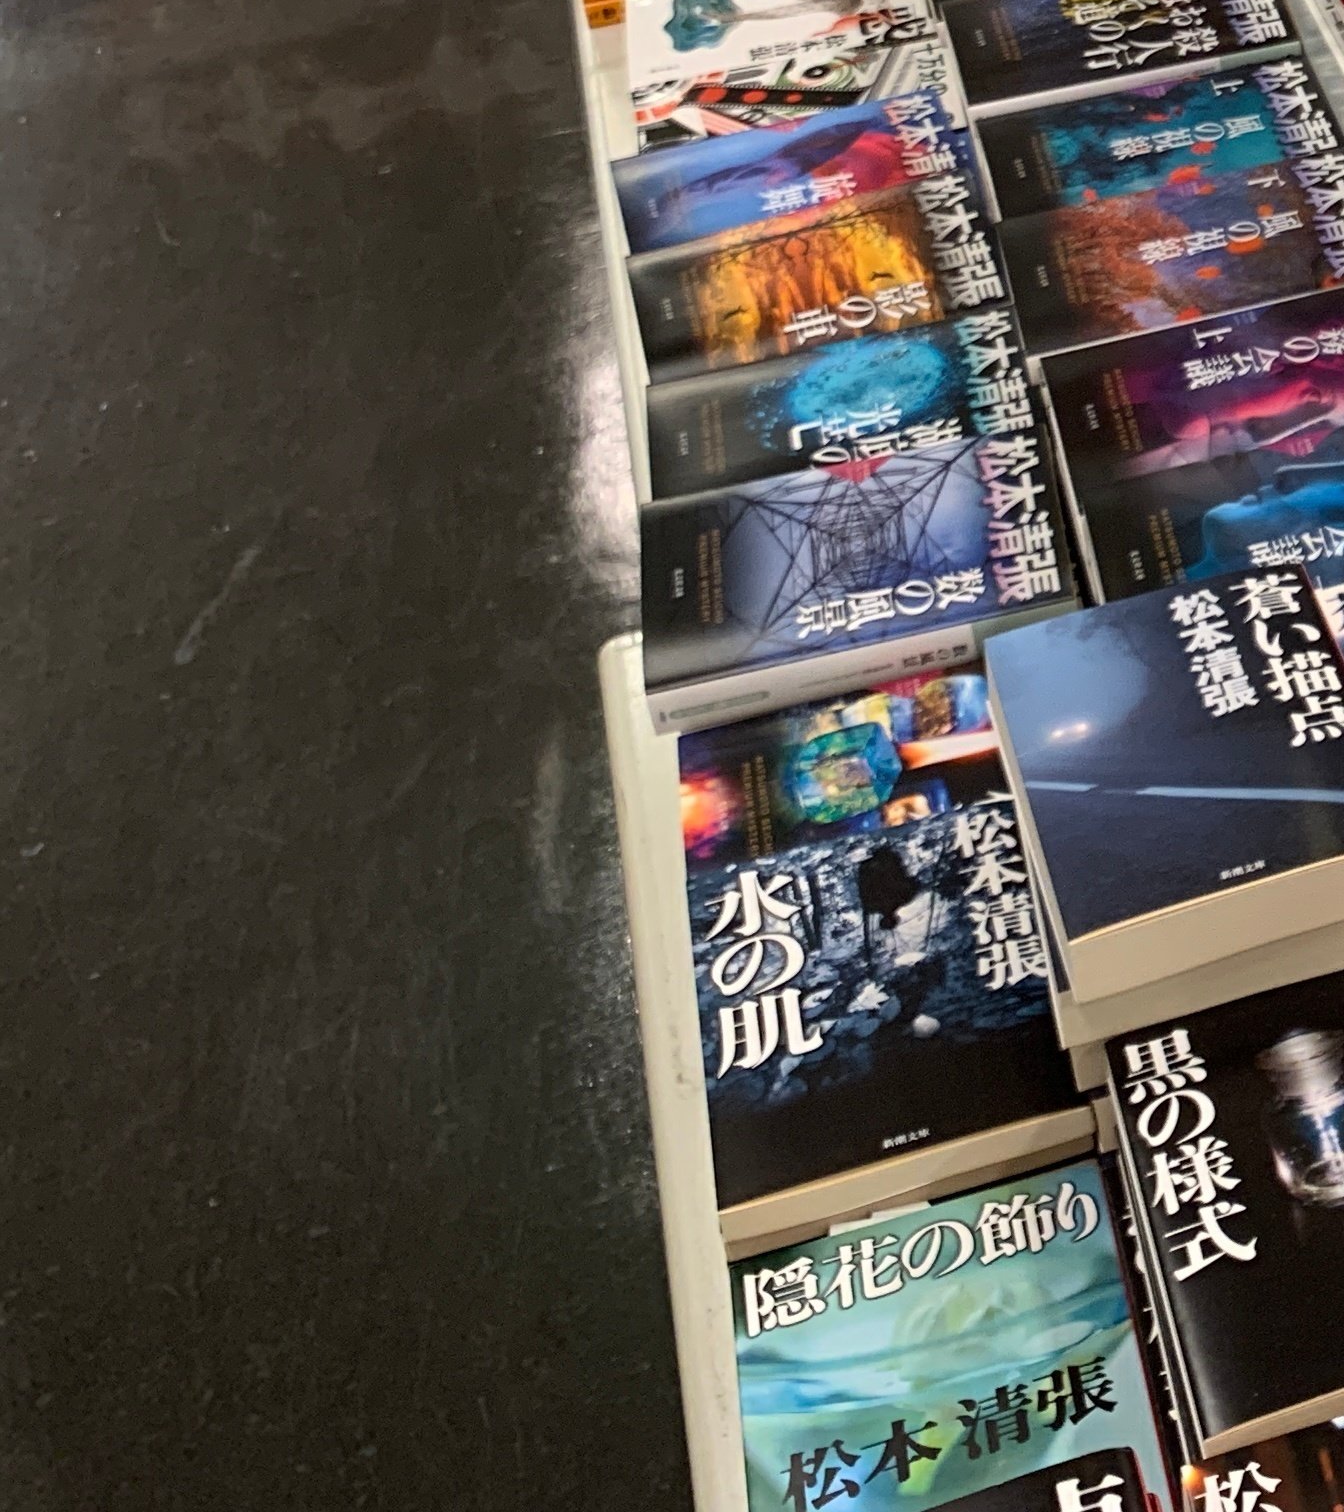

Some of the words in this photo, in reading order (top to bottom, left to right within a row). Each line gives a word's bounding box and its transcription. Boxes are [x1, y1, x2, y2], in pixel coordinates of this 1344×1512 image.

[1082, 28, 1219, 71] 殺人行
[1210, 76, 1245, 100] 上
[1108, 113, 1263, 162] 風の視線
[1246, 164, 1288, 191] 下
[913, 175, 1005, 308] 松本清張
[1136, 207, 1304, 265] 風の視線
[782, 280, 932, 344] 影の車
[1191, 326, 1234, 350] 上
[952, 309, 1034, 438] 松本清張
[974, 433, 1061, 604] 松本清張
[795, 568, 987, 641] 数の風景
[1166, 590, 1261, 717] 松本清張
[953, 808, 1050, 991] 松本清張
[1219, 859, 1266, 882] 新潮文庫
[703, 869, 825, 1081] 水の肌
[1120, 1026, 1260, 1285] 黒の様式
[739, 1178, 1103, 1339] 隠花の飾り
[778, 1356, 1119, 1512] 松本清張
